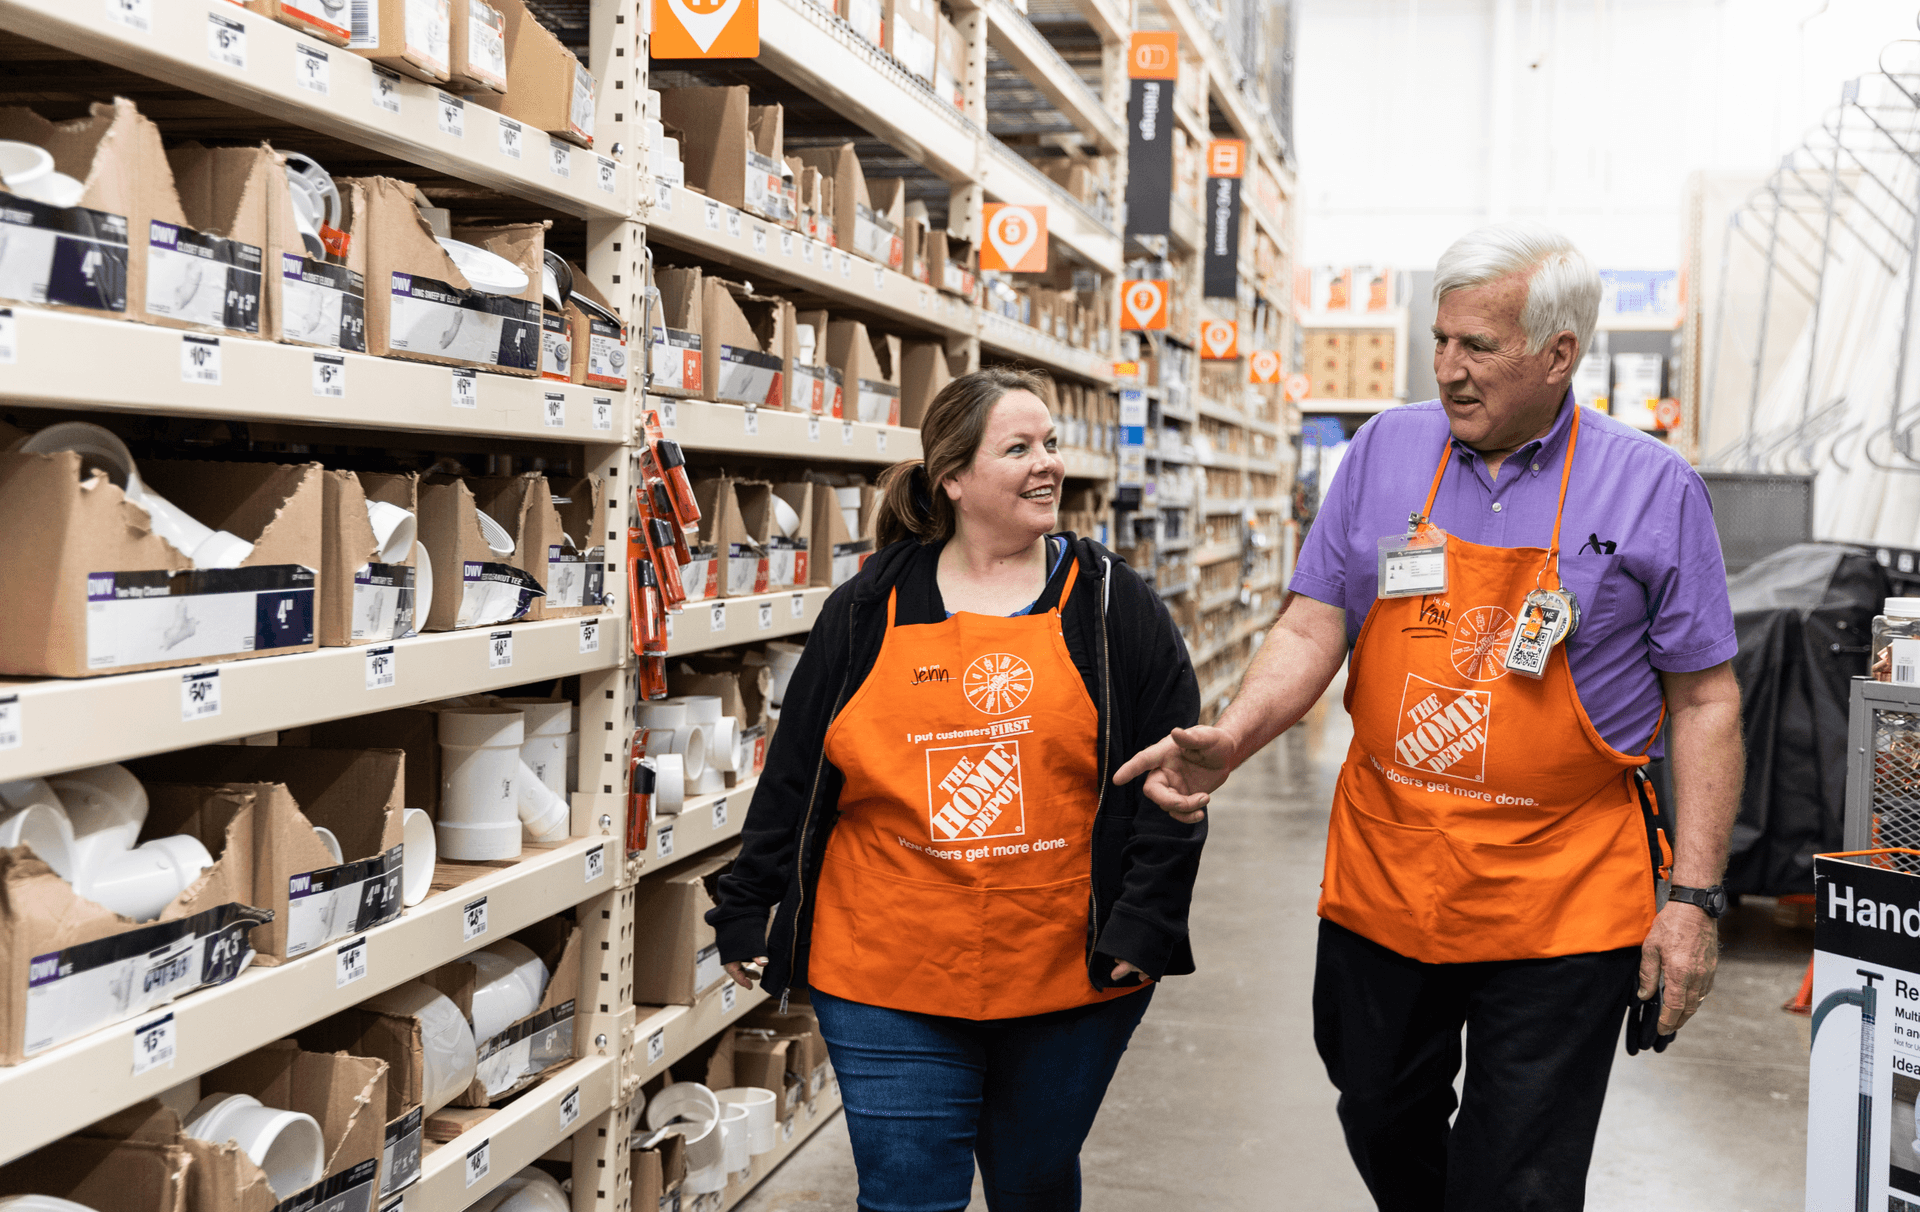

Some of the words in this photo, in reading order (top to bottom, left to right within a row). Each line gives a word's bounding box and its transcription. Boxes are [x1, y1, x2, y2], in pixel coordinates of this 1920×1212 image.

[1138, 82, 1160, 141] Fittings
[1216, 178, 1232, 206] PVC
[150, 223, 178, 246] DWV
[1005, 224, 1020, 243] 9
[1214, 206, 1231, 256] Cement
[282, 257, 303, 276] DWV
[391, 275, 412, 293] DWV
[411, 288, 424, 299] LONG
[424, 291, 440, 302] SWEEP
[464, 564, 482, 578] DWV
[88, 578, 114, 596] DWV
[277, 599, 294, 624] 4"
[1545, 610, 1555, 619] ME
[1406, 693, 1443, 726] THE
[907, 733, 912, 742] I
[914, 732, 933, 744] put
[936, 727, 990, 741] customers
[990, 720, 1030, 737] FIRST
[1396, 690, 1490, 768] HOME
[1426, 725, 1486, 774] DEPOT
[937, 755, 976, 795] THE
[1386, 769, 1424, 787] doers
[1426, 781, 1451, 793] get
[1453, 787, 1492, 802] more
[931, 743, 1018, 840] HOME
[967, 775, 1021, 838] DEPOT
[925, 846, 963, 860] doers
[965, 845, 990, 862] get
[992, 841, 1030, 857] more
[1033, 837, 1069, 851] done.
[290, 875, 311, 893] DWV
[311, 882, 324, 893] WYE
[365, 884, 381, 907] 4"
[30, 958, 59, 981] DWV
[1895, 979, 1920, 1002] Re
[1894, 1023, 1904, 1035] in
[1894, 1038, 1904, 1046] Not
